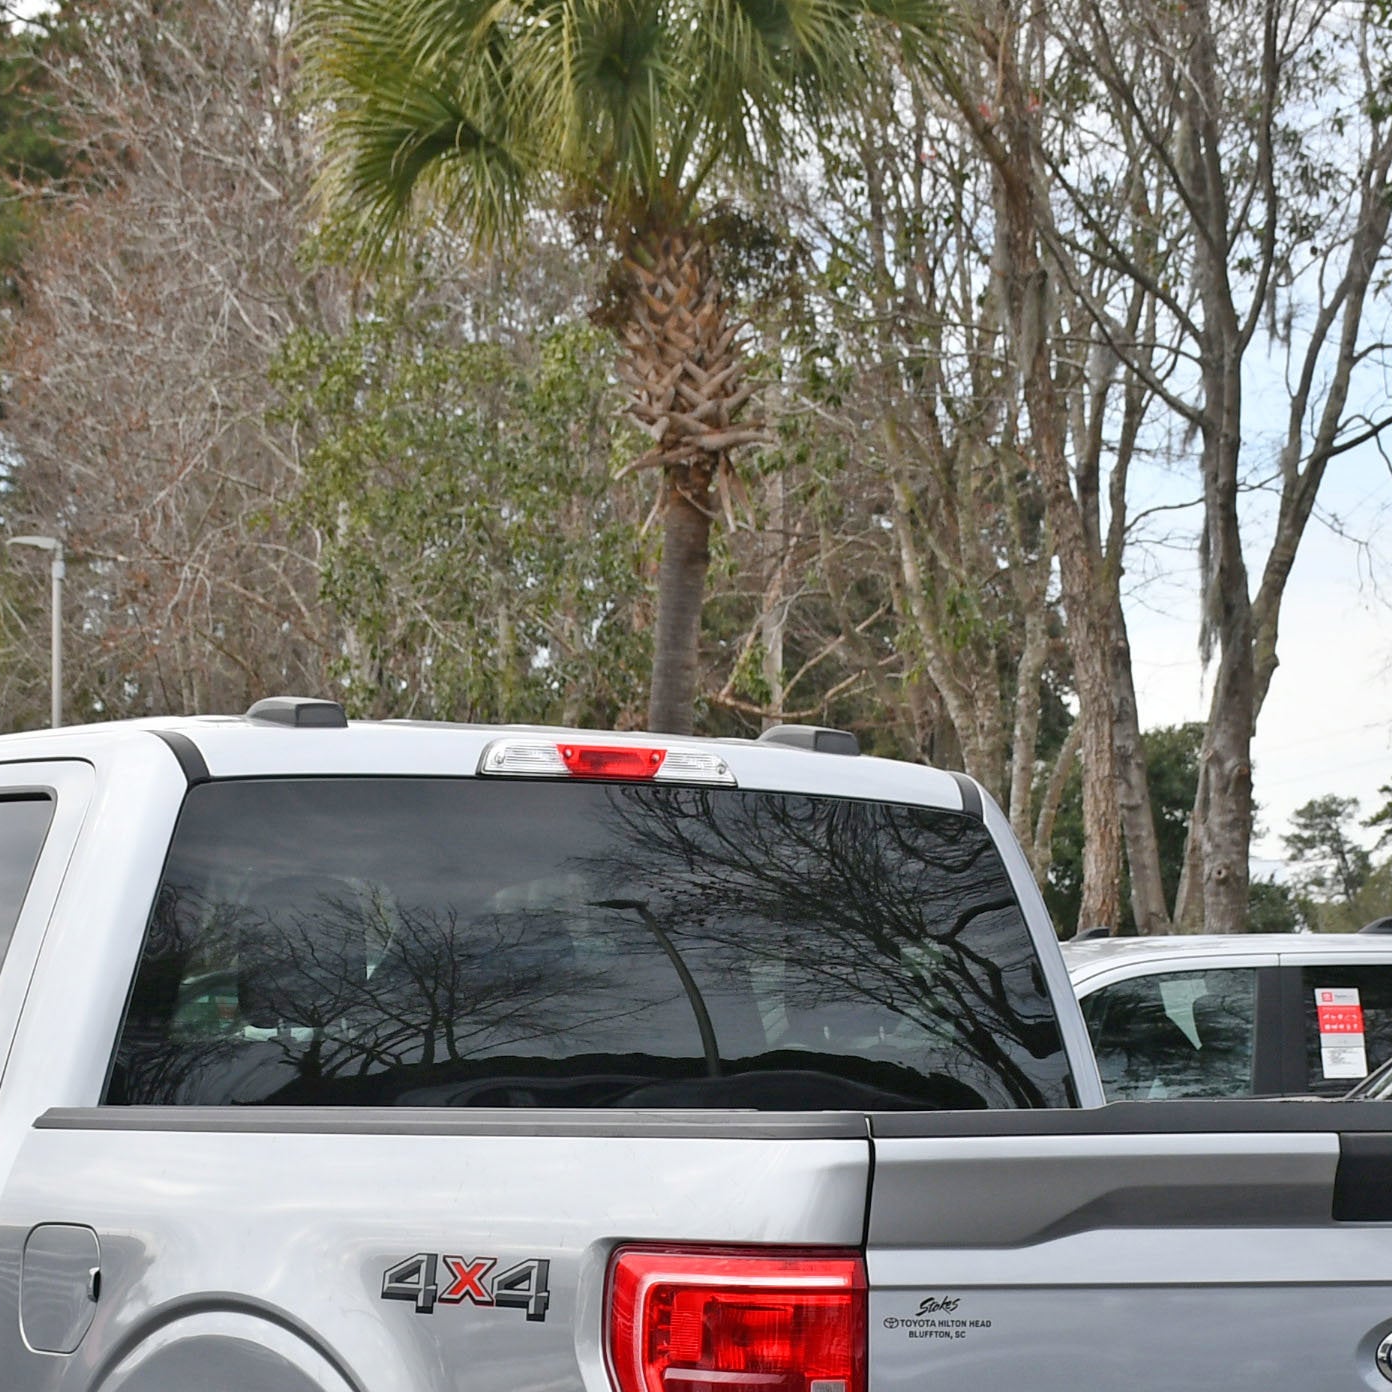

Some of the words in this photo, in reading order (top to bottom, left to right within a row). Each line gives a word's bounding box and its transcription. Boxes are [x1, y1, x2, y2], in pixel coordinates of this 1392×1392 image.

[915, 1295, 960, 1316] Stokes
[900, 1319, 936, 1328] TOYOTA
[938, 1319, 967, 1328] HILTON
[969, 1319, 992, 1328] HEAD
[908, 1330, 953, 1340] BLUFFTON,
[955, 1330, 966, 1339] SC
